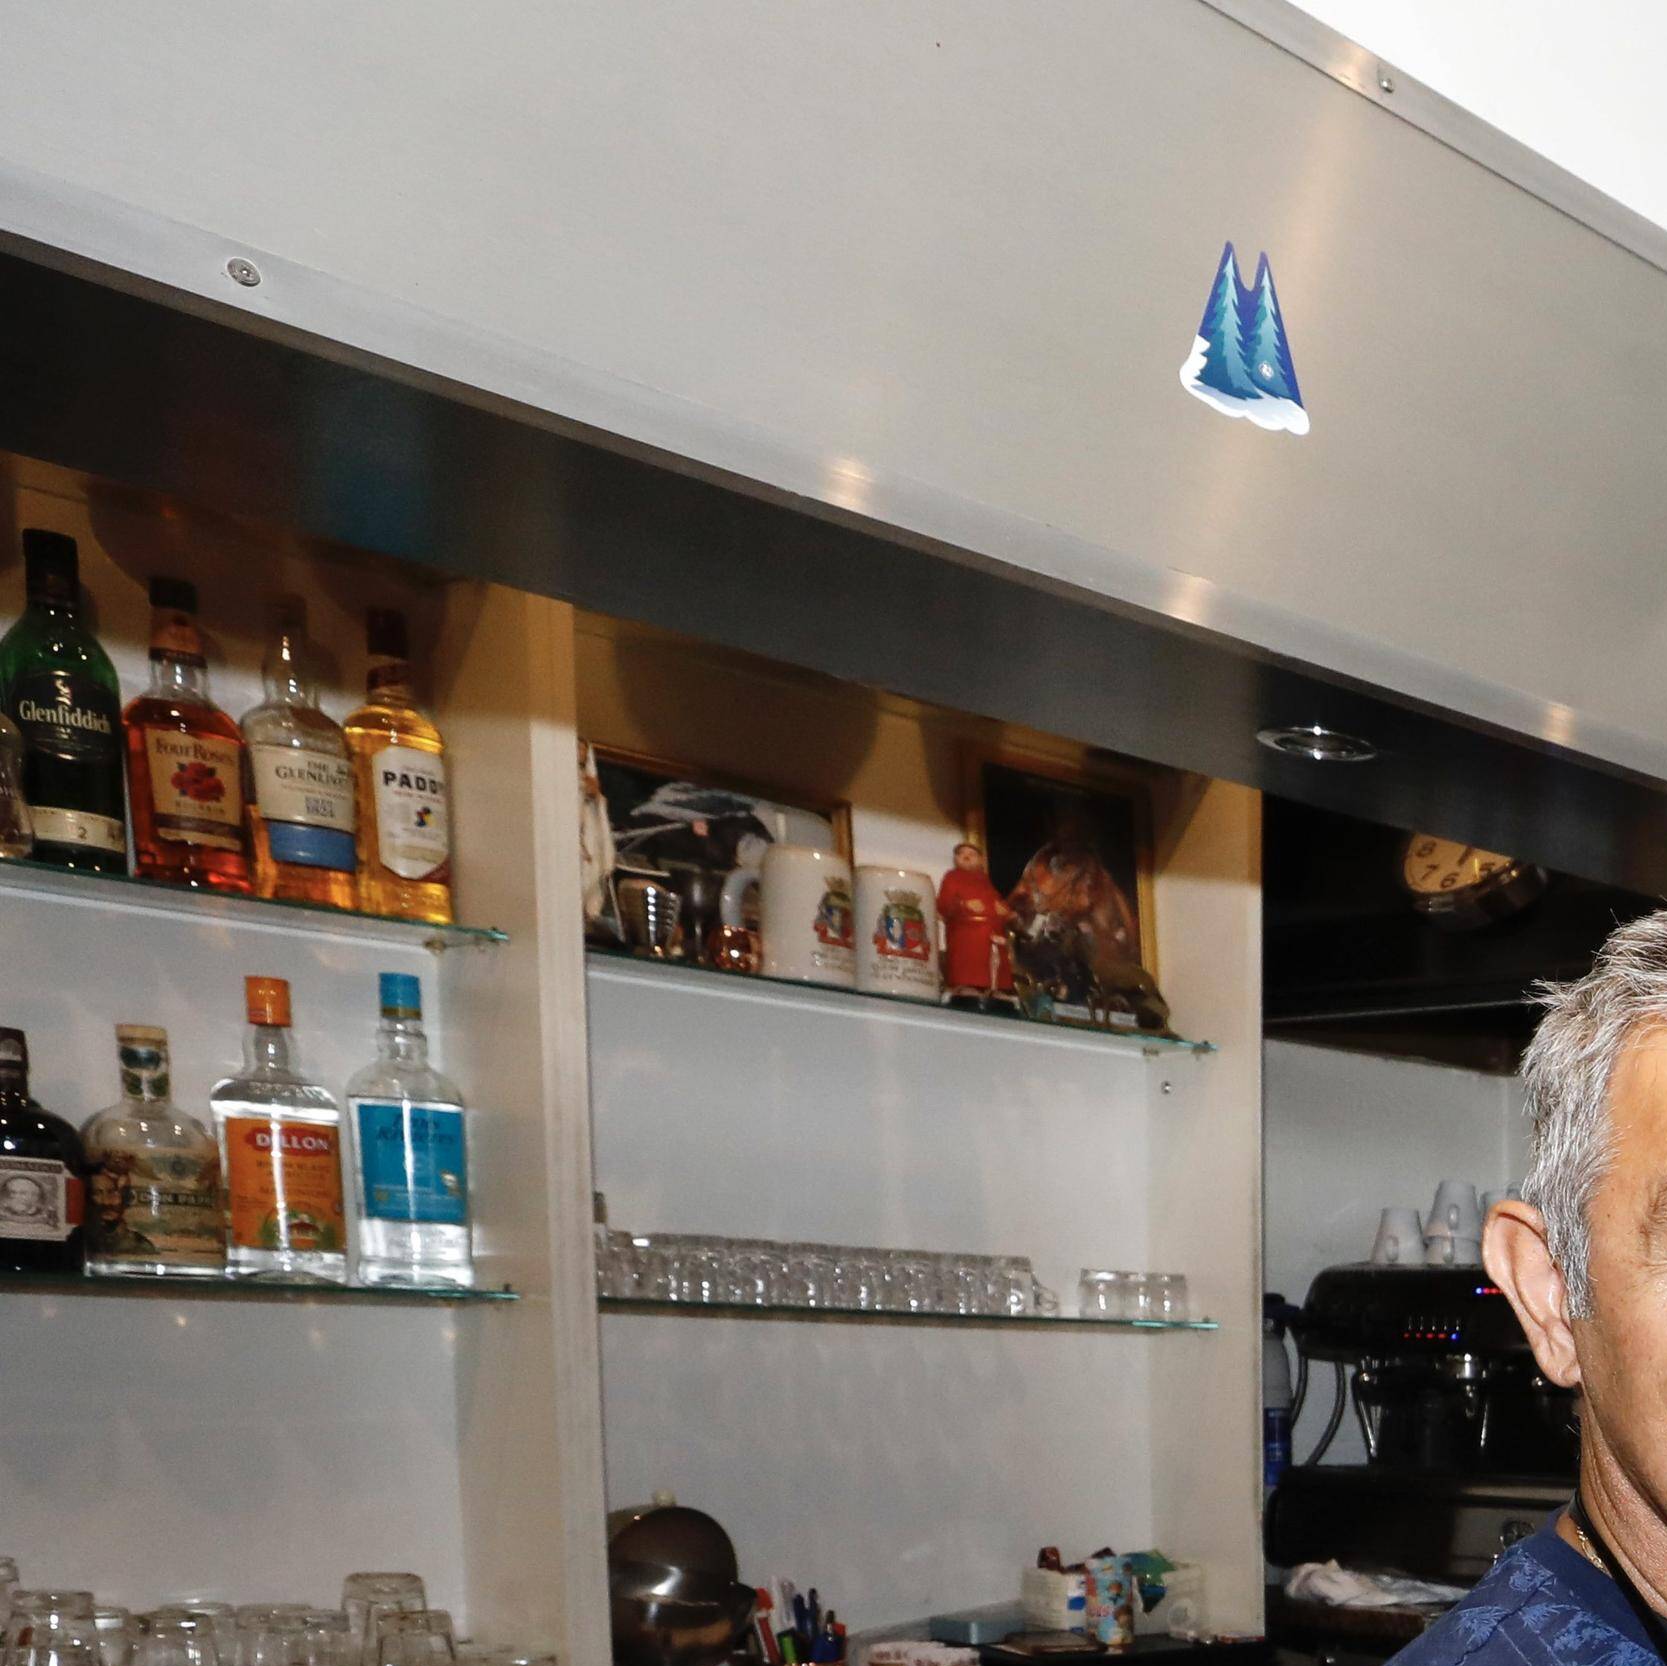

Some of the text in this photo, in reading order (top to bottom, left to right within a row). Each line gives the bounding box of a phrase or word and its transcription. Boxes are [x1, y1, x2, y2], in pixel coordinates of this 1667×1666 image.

[19, 699, 112, 735] Glenfiddich
[1421, 864, 1440, 881] 7
[1440, 872, 1459, 889] 6
[255, 1133, 330, 1151] DLLON
